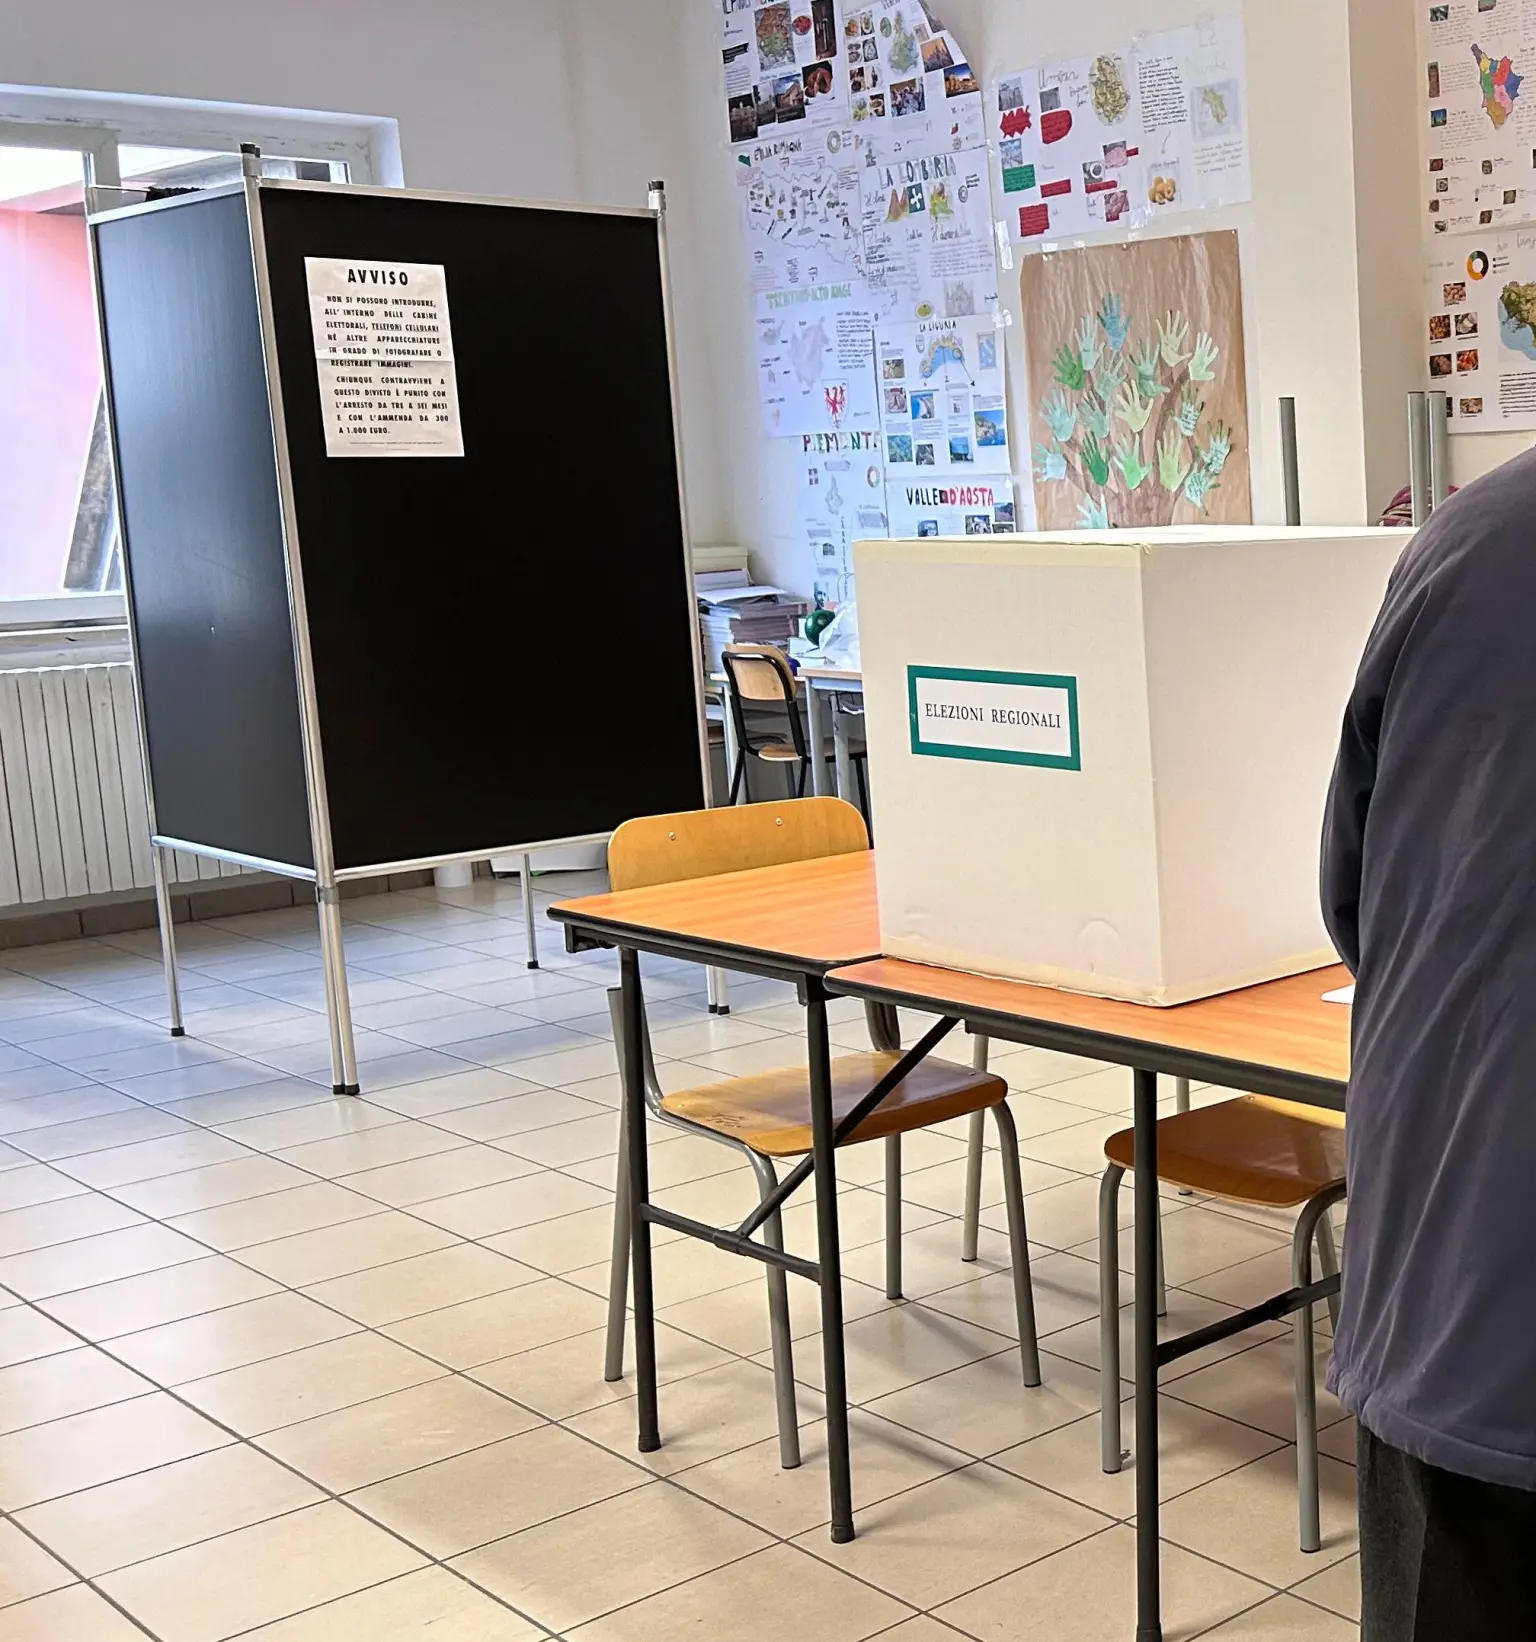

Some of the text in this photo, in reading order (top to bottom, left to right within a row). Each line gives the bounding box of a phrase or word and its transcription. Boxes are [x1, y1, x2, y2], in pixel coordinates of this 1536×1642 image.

[348, 269, 408, 286] AVVISO
[372, 323, 402, 331] TELEFONI
[405, 324, 439, 332] CELLULARI
[346, 334, 367, 342] ALTRE
[377, 336, 440, 344] APPARECCHIATURE
[385, 348, 431, 356] FOTOGRAFARE
[336, 376, 372, 384] CHIUNQUE
[381, 376, 432, 384] CONTRAVVIENE
[906, 487, 939, 506] VALLE
[925, 703, 1061, 728] ELEZIONI REGIONALI
